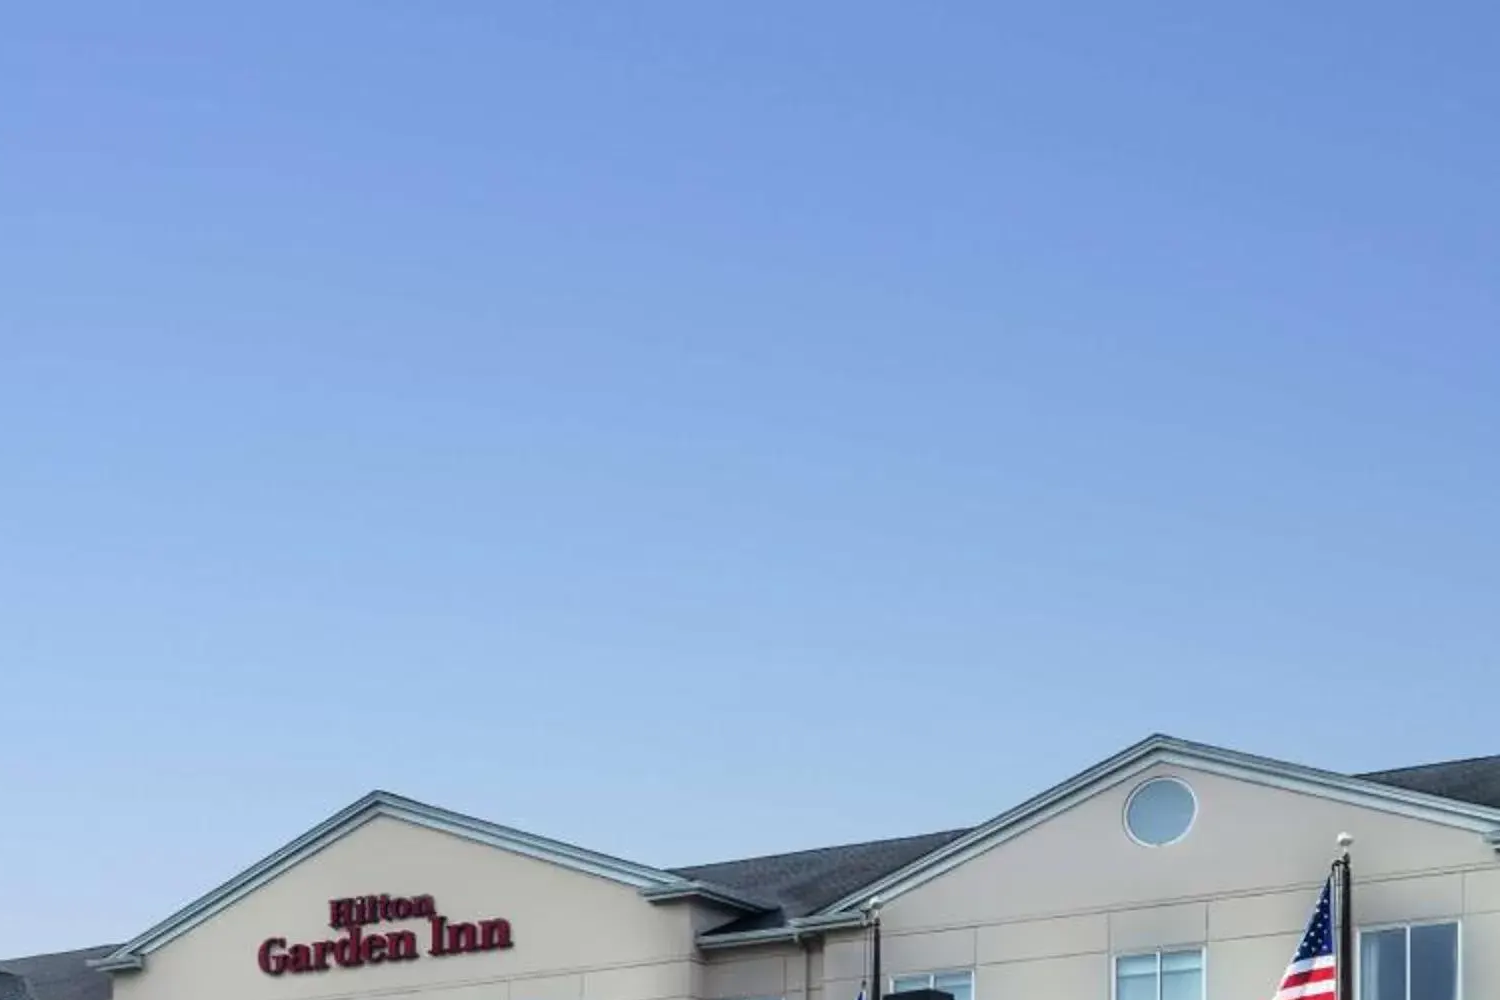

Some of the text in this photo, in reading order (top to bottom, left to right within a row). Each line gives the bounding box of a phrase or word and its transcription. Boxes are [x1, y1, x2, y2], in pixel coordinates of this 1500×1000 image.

[328, 893, 436, 928] Hilton
[257, 914, 514, 977] Garden Inn
